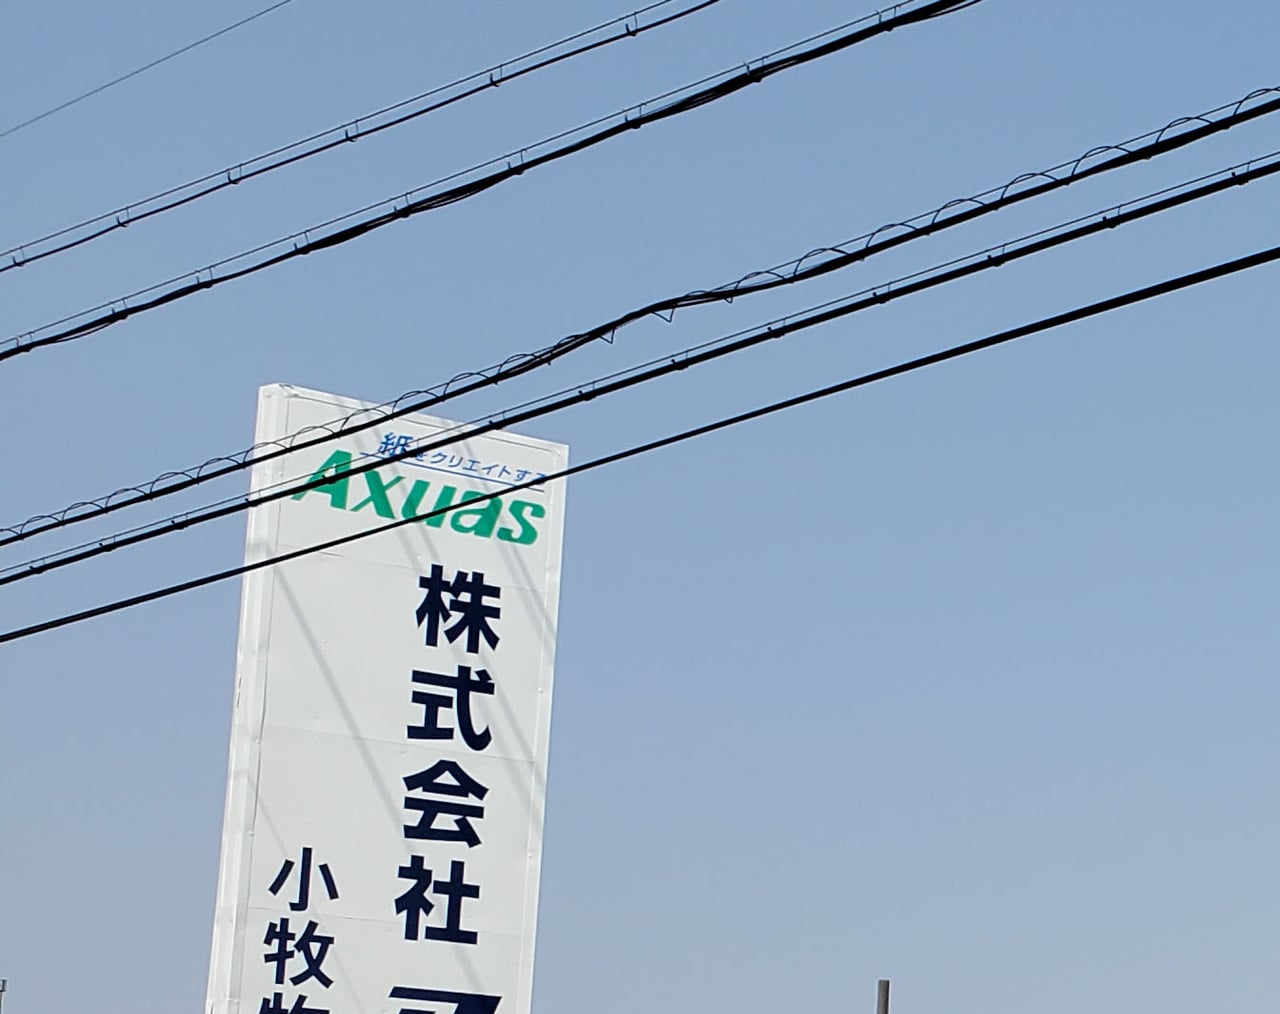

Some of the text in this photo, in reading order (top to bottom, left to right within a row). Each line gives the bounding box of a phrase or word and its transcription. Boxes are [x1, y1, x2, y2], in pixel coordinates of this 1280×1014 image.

[290, 449, 546, 546] Axuas
[394, 563, 501, 945] 株式会社
